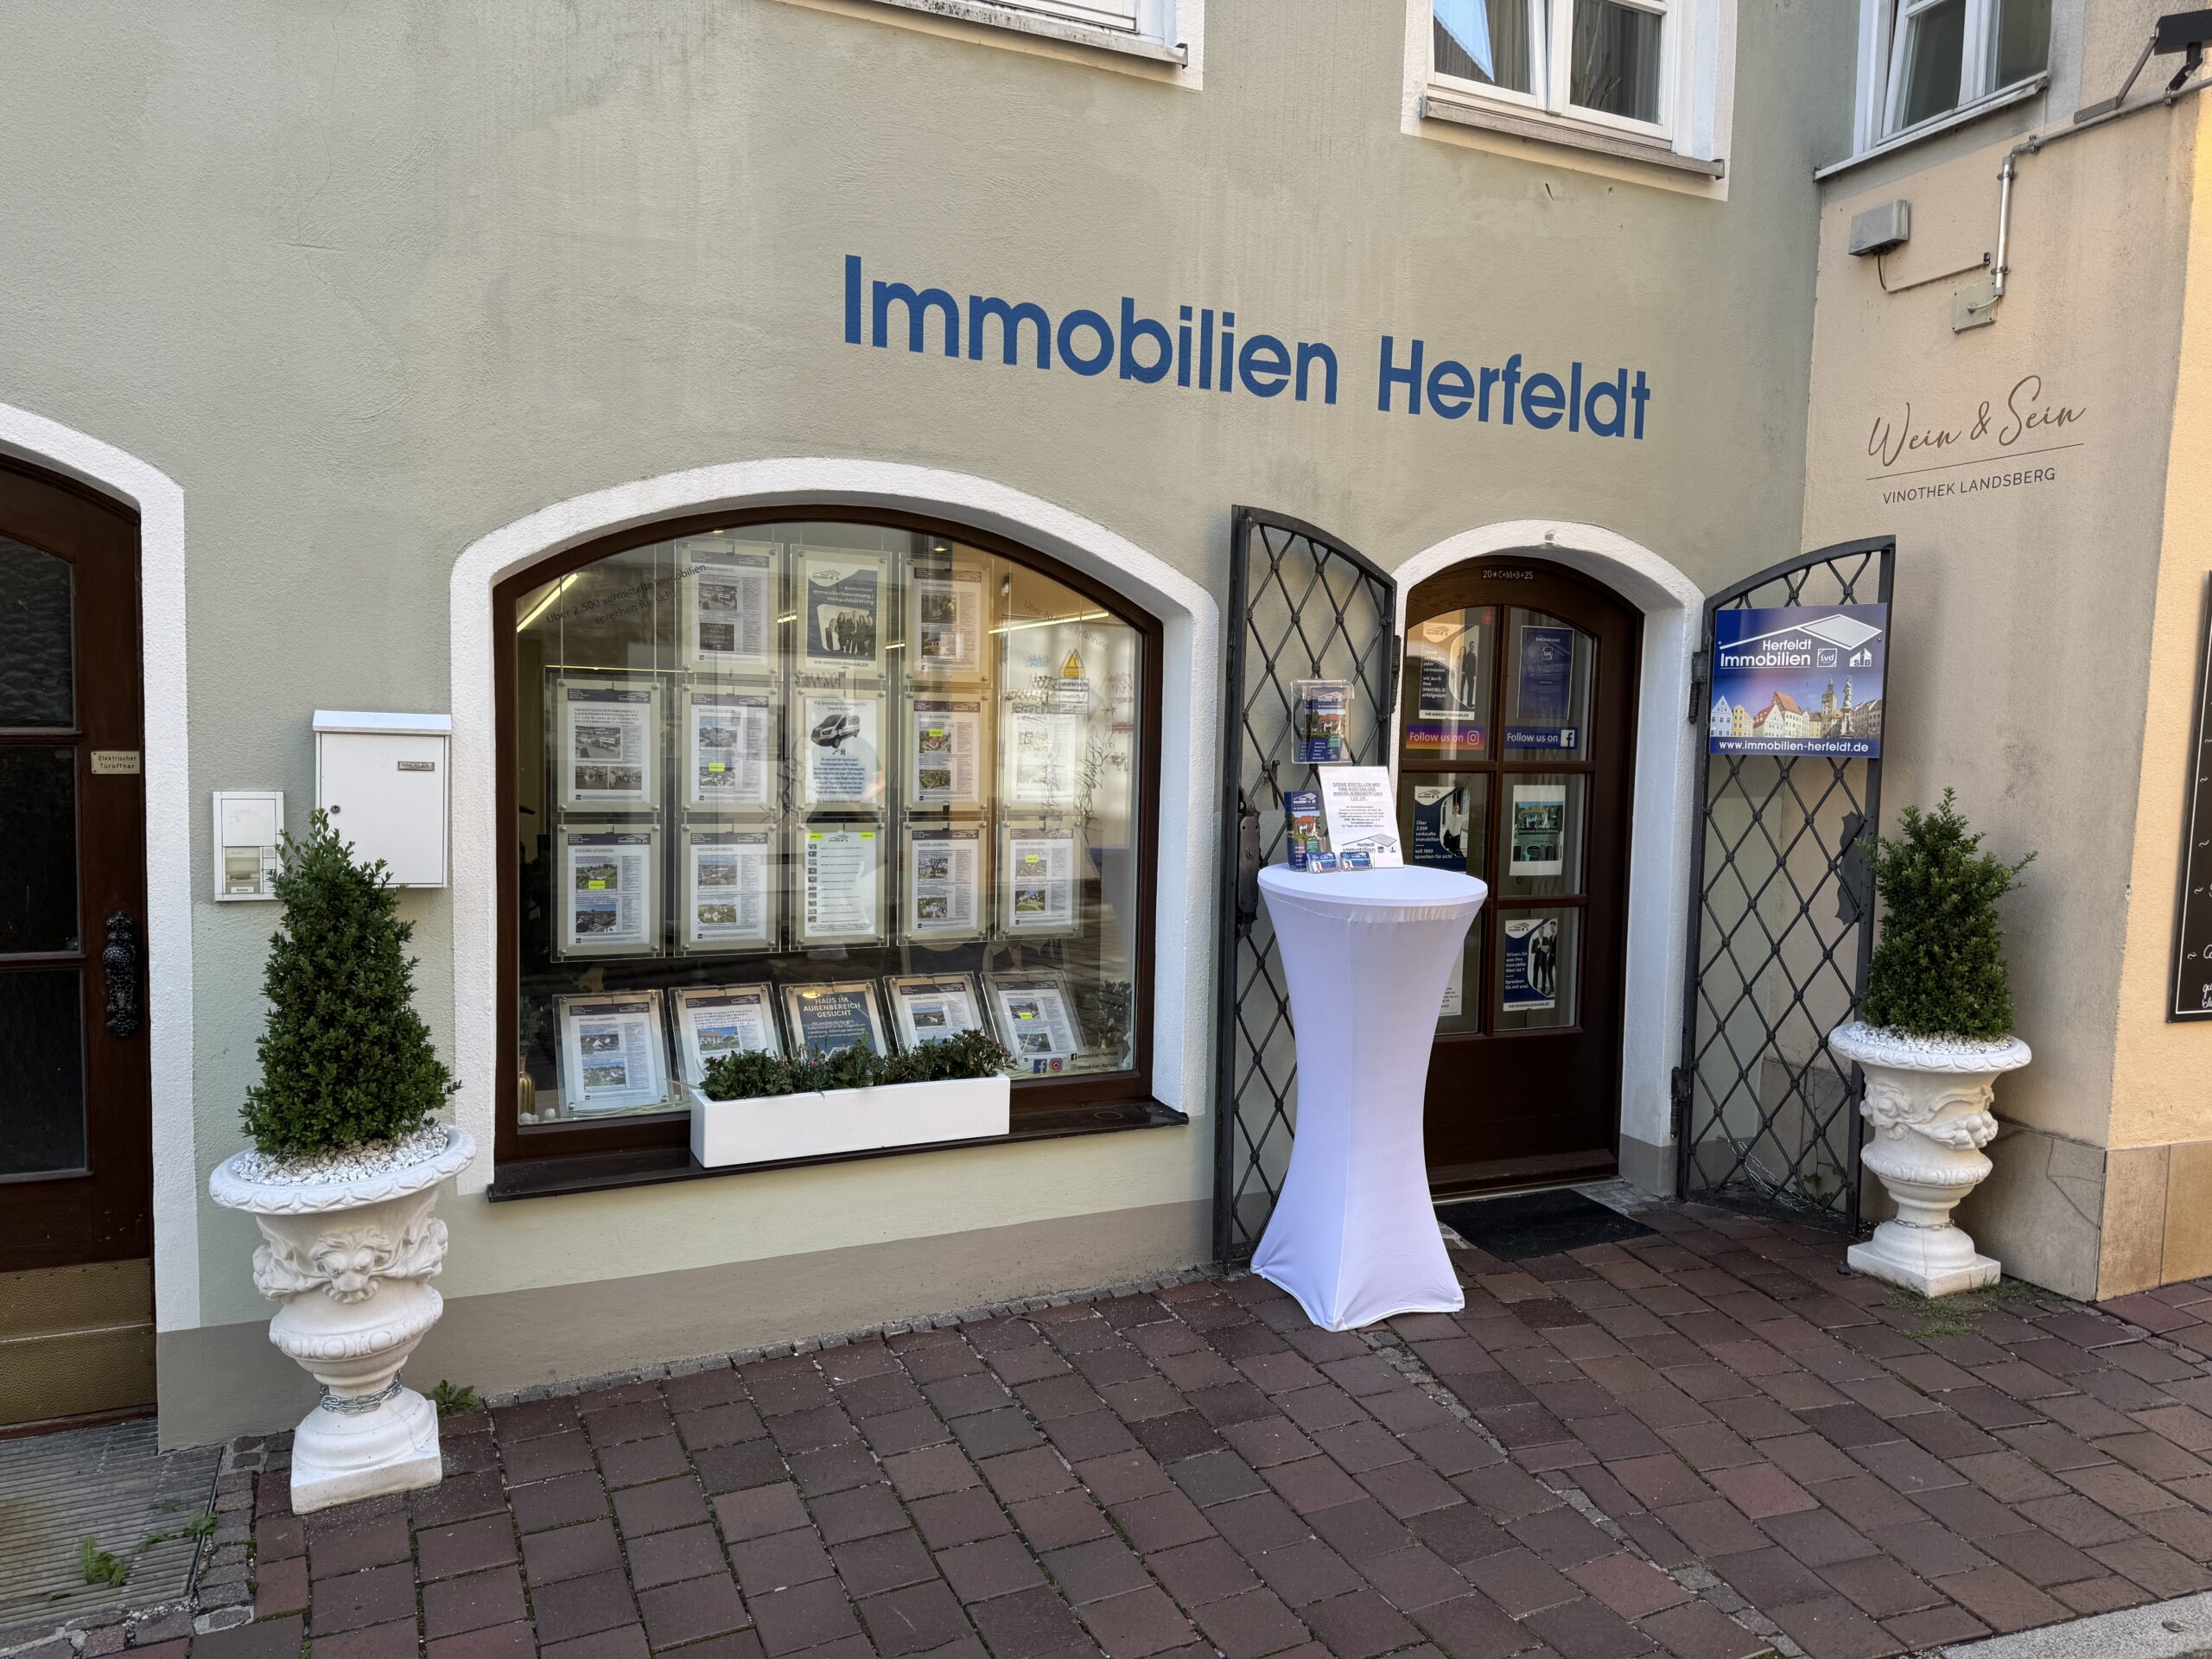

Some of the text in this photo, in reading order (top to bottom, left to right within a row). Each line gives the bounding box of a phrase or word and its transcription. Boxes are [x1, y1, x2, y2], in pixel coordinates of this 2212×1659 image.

[845, 253, 1651, 440] Immobilien Herfeldt
[1868, 375, 2086, 467] Wein & Sein
[1883, 467, 2056, 504] VINOTHEK LANDSBERG
[547, 609, 569, 623] Über
[602, 582, 653, 604] vermittelte
[656, 564, 707, 588] Immobilien
[812, 589, 871, 600] Immobilienbewertung
[595, 605, 638, 625] sprechen
[1024, 601, 1041, 614] Über
[1044, 610, 1053, 620] 30
[1074, 627, 1110, 651] Erfahrung
[1763, 639, 1812, 651] Herfeldt
[1720, 652, 1811, 667] Immobilien
[1409, 732, 1464, 742] Follow us on
[1507, 733, 1535, 741] Follow
[1719, 740, 1869, 753] www.immobilien-herfeldt.de
[803, 1002, 861, 1012] AUßENBEREICH
[817, 1009, 852, 1018] GESUCHT
